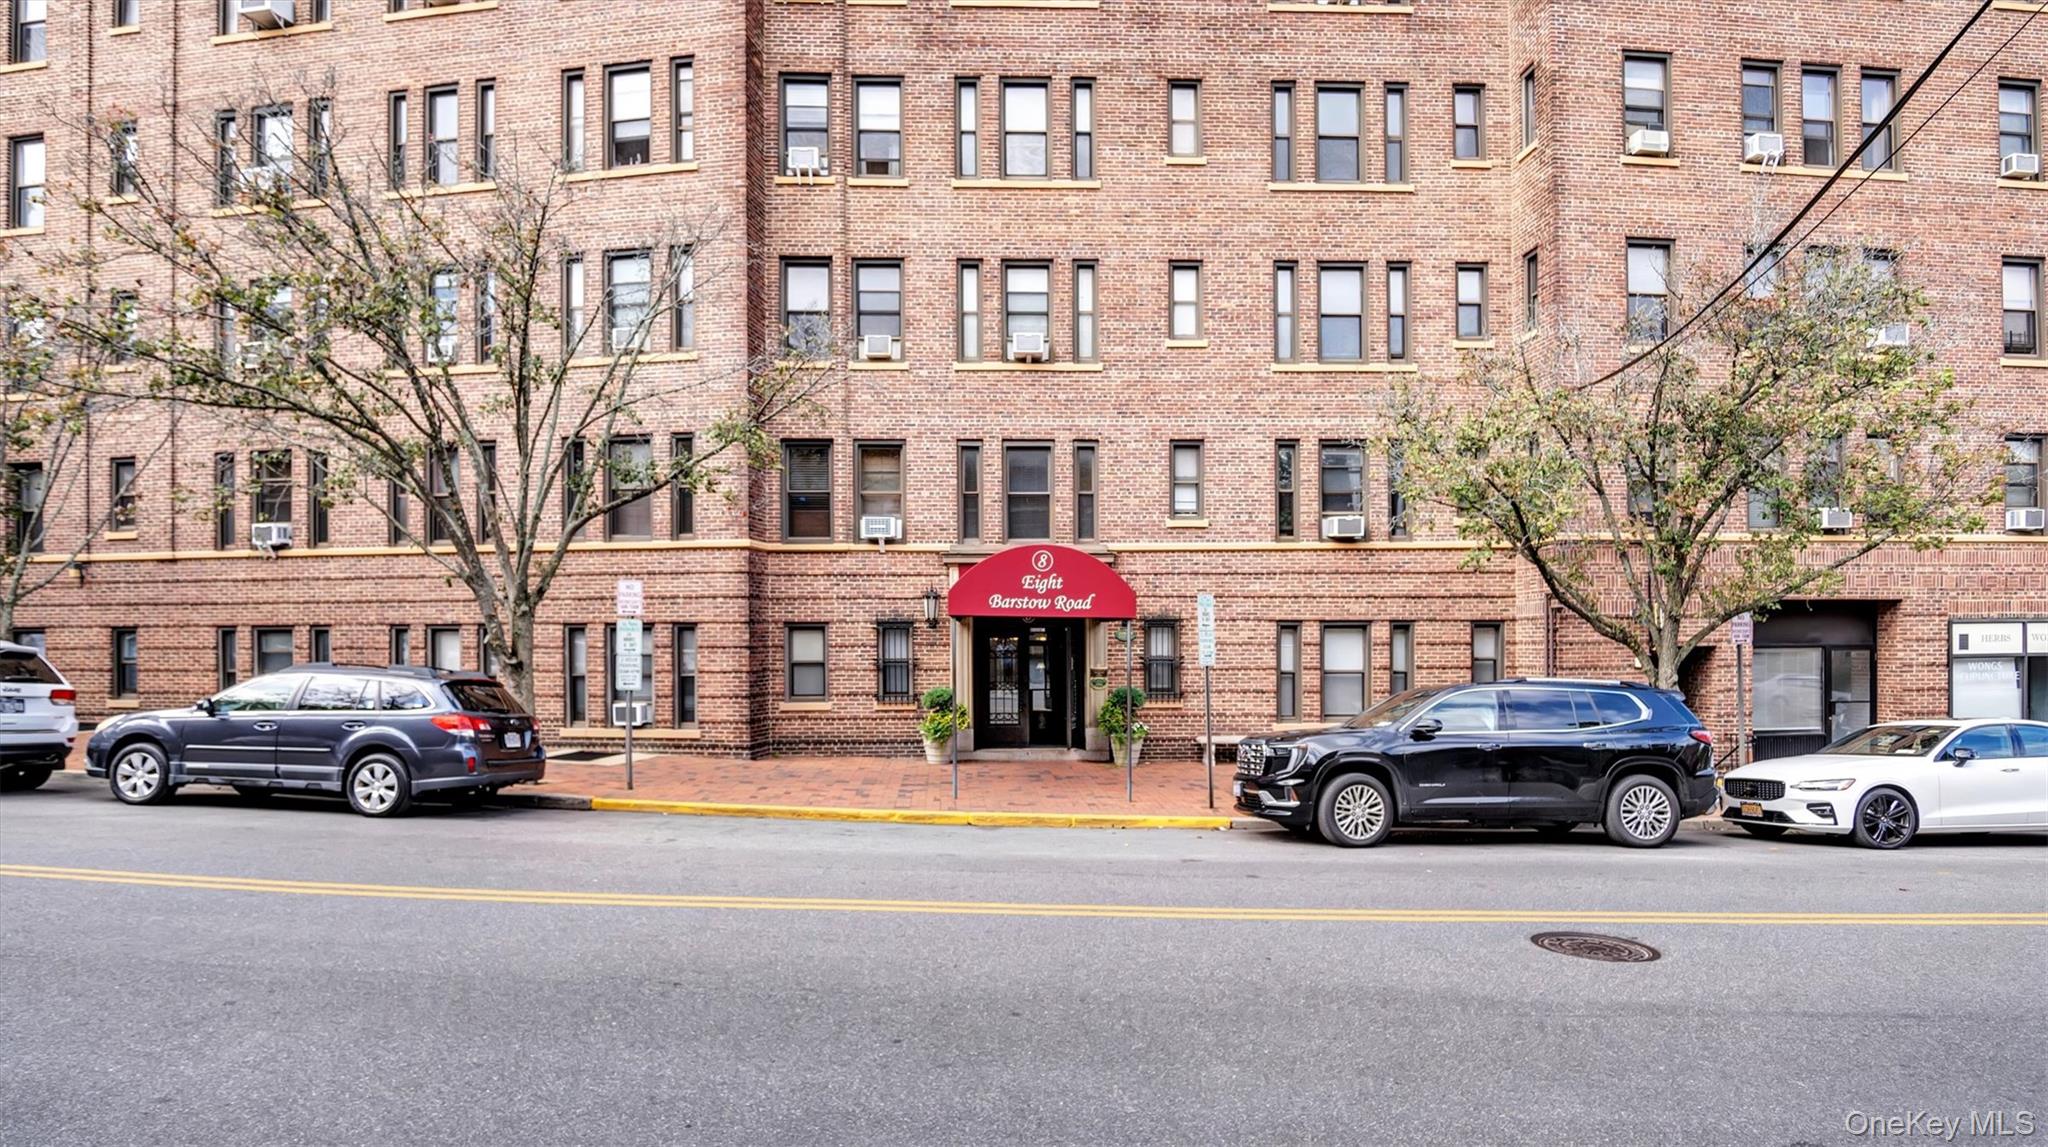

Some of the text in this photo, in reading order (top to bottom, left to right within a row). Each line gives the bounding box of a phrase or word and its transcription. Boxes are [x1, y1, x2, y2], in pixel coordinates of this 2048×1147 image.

[1037, 554, 1048, 568] 8
[1021, 573, 1064, 594] Eight
[988, 593, 1096, 612] Barstow Road
[1981, 633, 2011, 642] HERBS
[1967, 661, 2003, 671] WONGS
